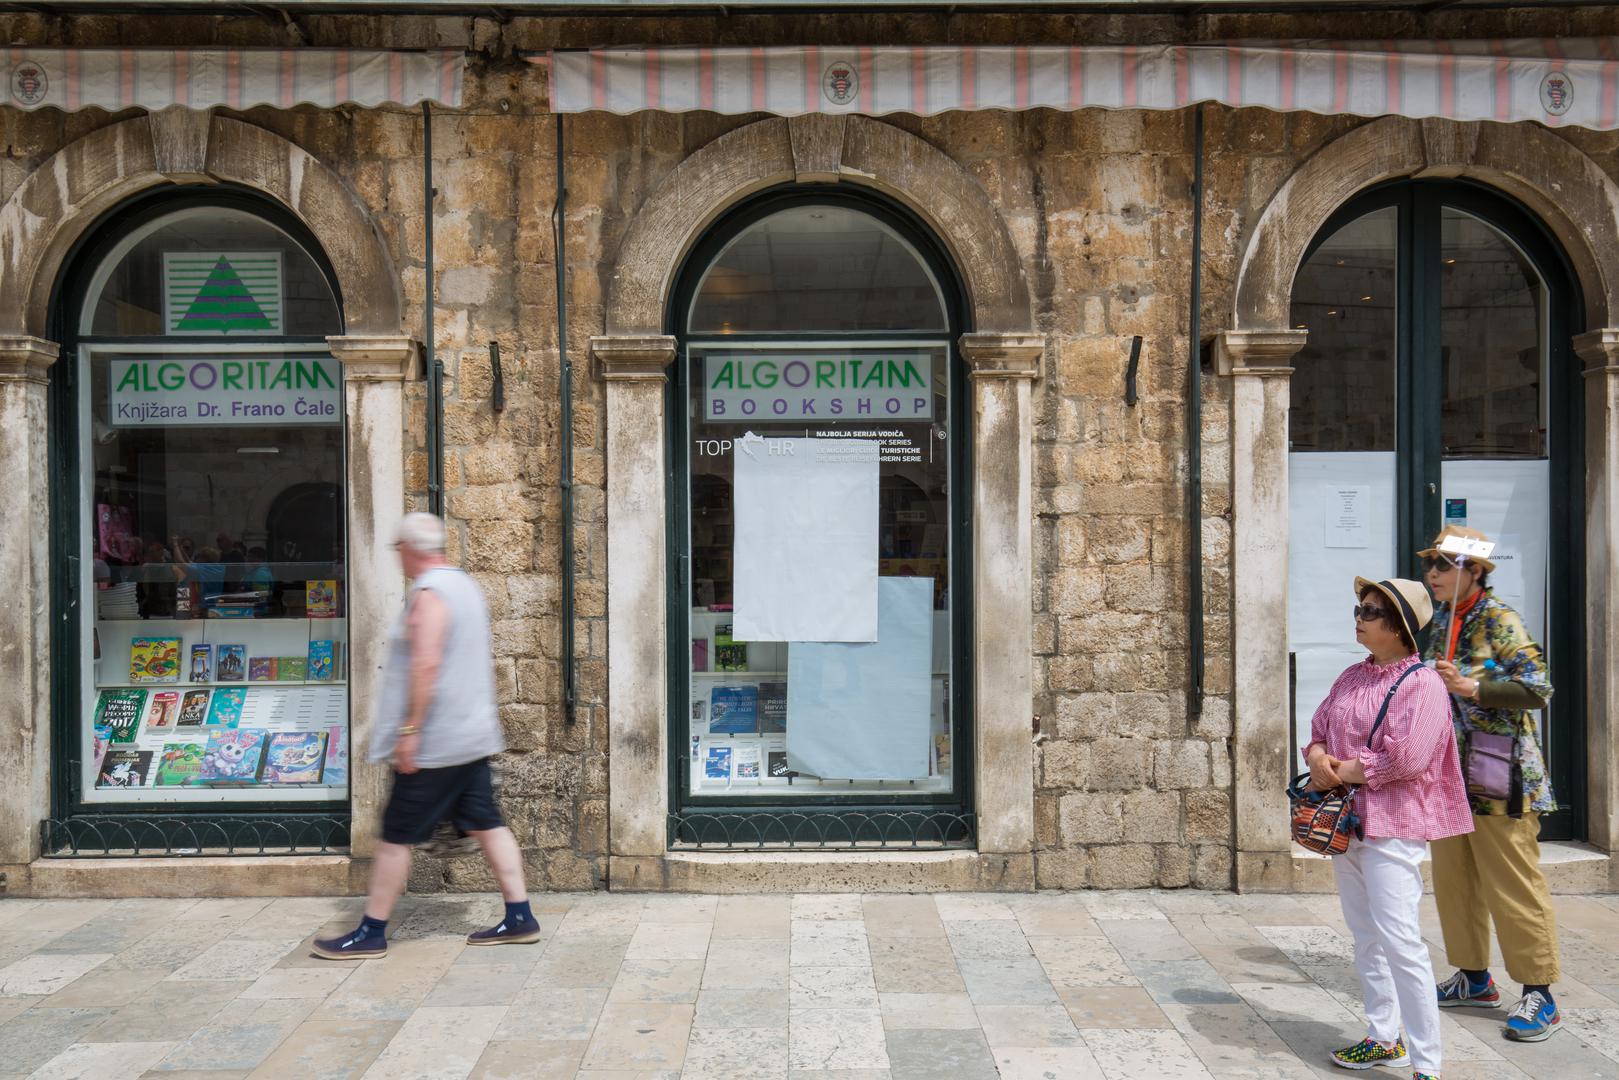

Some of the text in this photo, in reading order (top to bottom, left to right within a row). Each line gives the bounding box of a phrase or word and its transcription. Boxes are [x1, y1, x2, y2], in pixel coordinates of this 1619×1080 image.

[116, 361, 336, 392] ALGORITAM
[711, 360, 926, 389] ALGORITAM
[117, 397, 335, 422] Knjižara Dr. Frano Čale
[712, 398, 926, 415] BOOKSHOP
[696, 440, 794, 456] TOP HR
